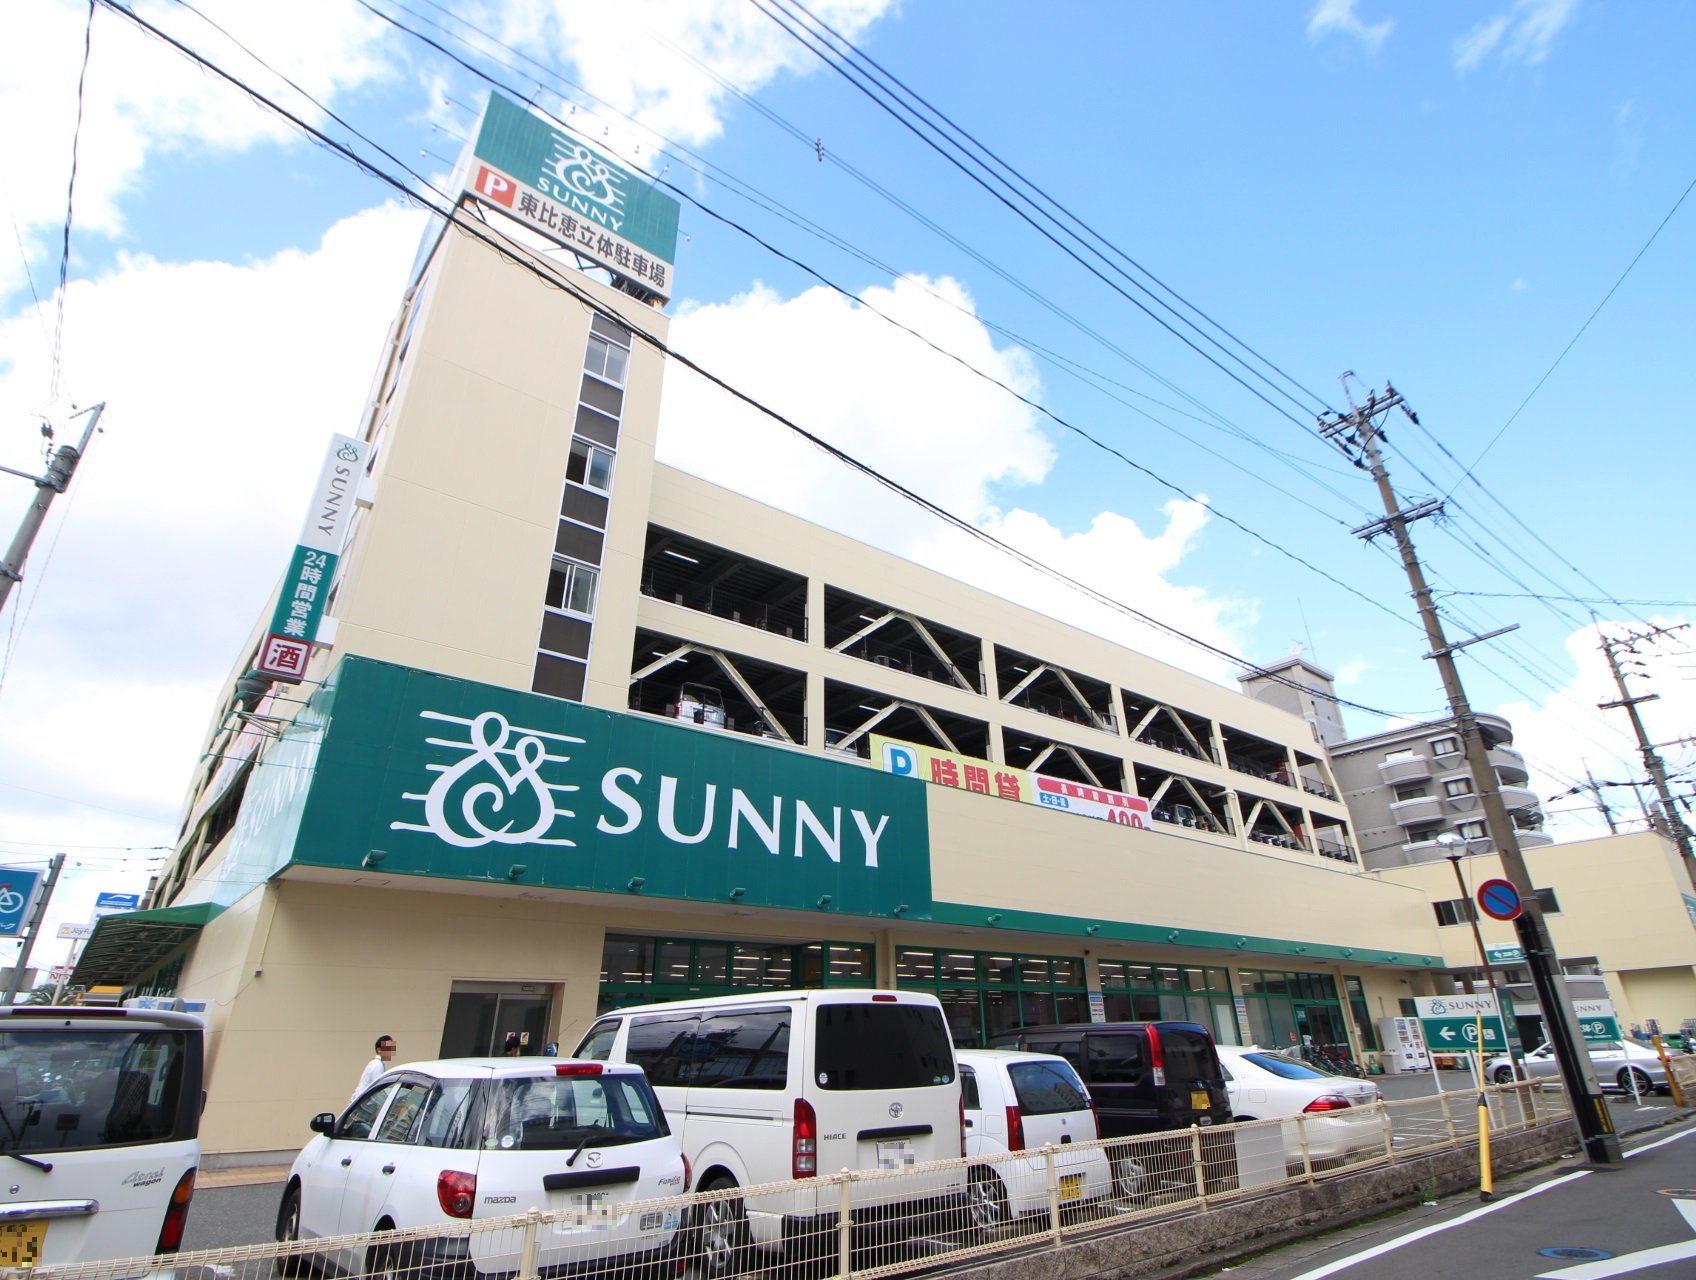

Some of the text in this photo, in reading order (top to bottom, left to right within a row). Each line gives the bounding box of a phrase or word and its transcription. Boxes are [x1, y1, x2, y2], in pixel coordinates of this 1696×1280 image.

[537, 175, 624, 233] SUNNY
[483, 170, 666, 289] P 東比恵立体駐車場
[317, 464, 351, 537] SUNNY
[283, 551, 327, 637] 24時間営業
[268, 642, 303, 671] 酒
[930, 757, 1021, 800] 時間貸
[595, 766, 891, 868] SUNNY
[1448, 1000, 1492, 1011] SUNNY
[823, 1132, 847, 1141] HIACE
[133, 1177, 162, 1188] wagon
